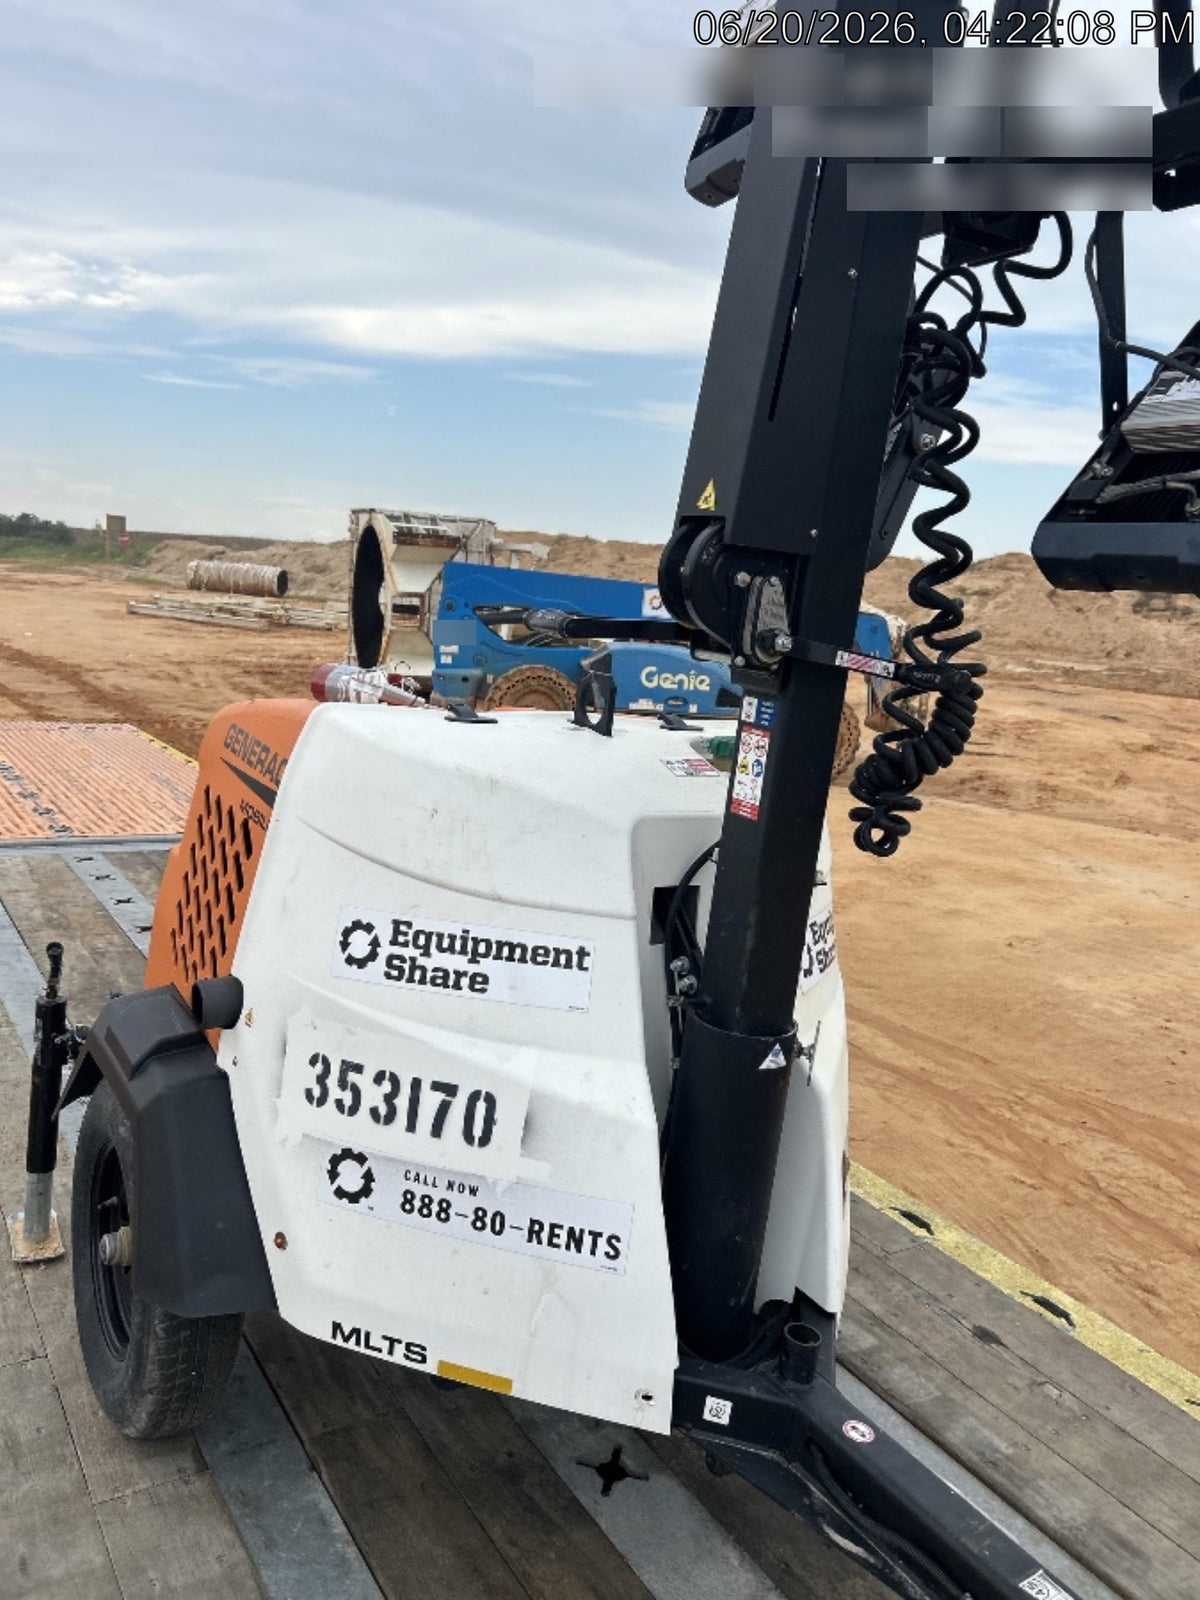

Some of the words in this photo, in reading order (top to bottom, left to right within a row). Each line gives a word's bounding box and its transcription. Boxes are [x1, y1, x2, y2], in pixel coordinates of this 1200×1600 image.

[640, 665, 711, 692] Genie
[388, 918, 592, 972] Equipment
[383, 952, 490, 995] Share
[304, 1051, 498, 1149] 353170
[403, 1169, 439, 1189] CALL
[445, 1178, 480, 1198] NOW
[399, 1188, 623, 1262] 888-80-RENTS
[331, 1320, 428, 1365] MLTS
